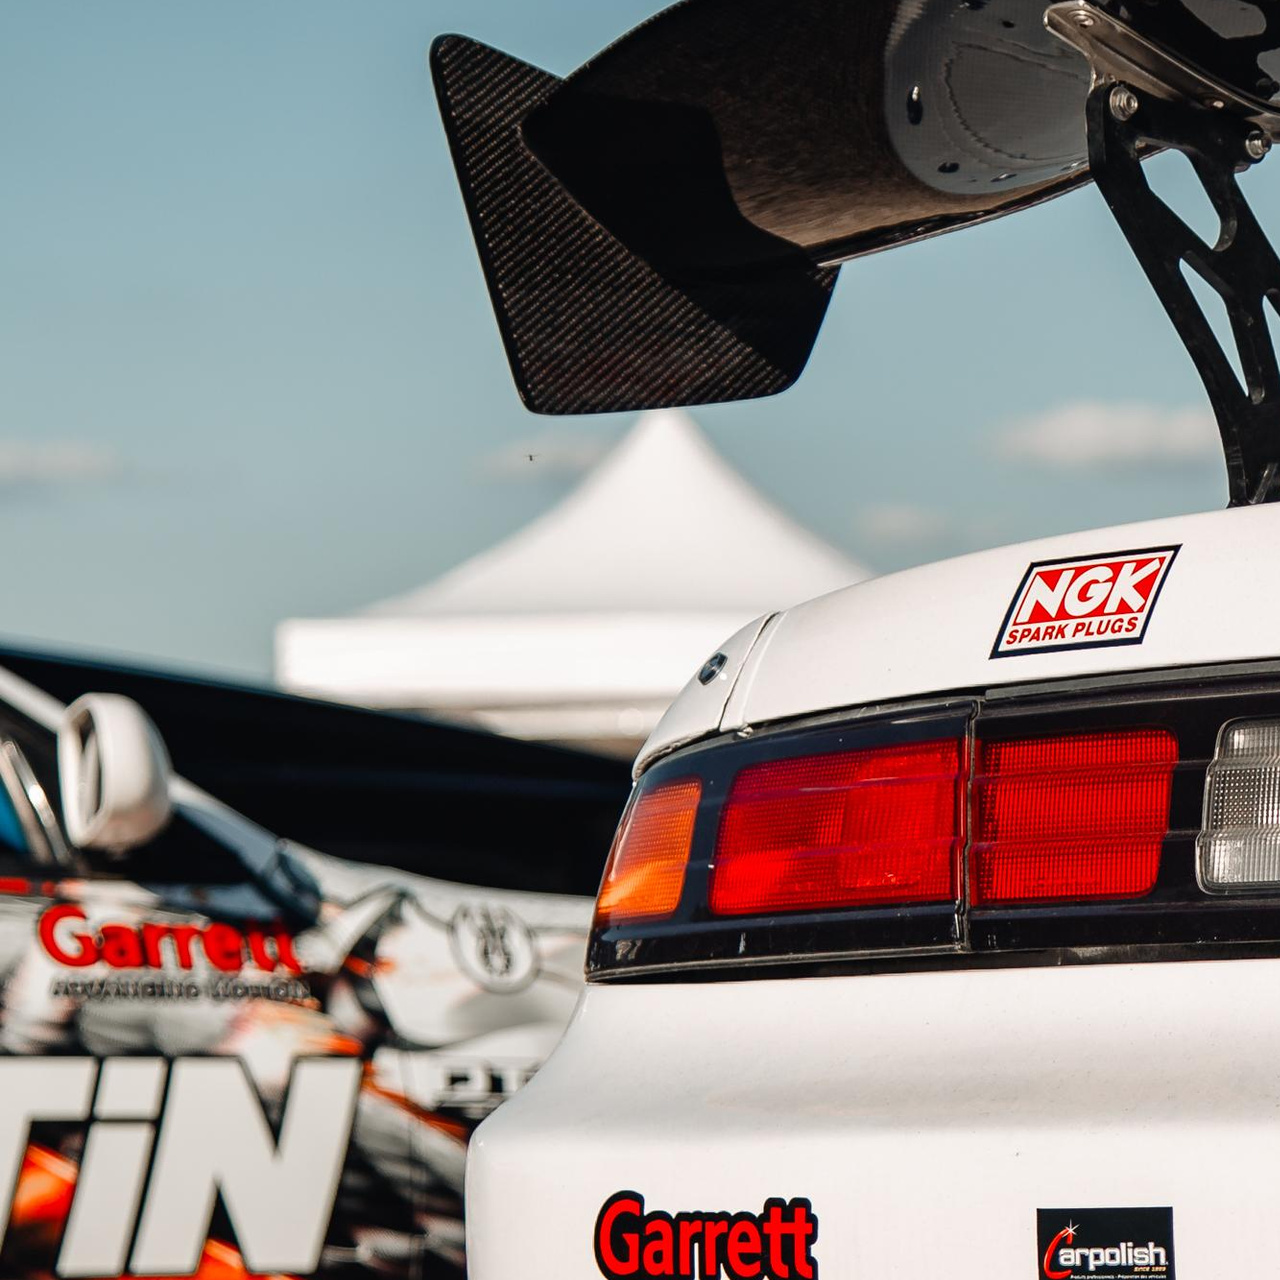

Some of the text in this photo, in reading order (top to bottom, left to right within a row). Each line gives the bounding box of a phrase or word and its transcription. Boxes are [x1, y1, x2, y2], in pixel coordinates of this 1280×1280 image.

[1016, 557, 1161, 623] NGK
[1006, 616, 1139, 645] SPARK PLUGS
[599, 1198, 814, 1279] Garrett
